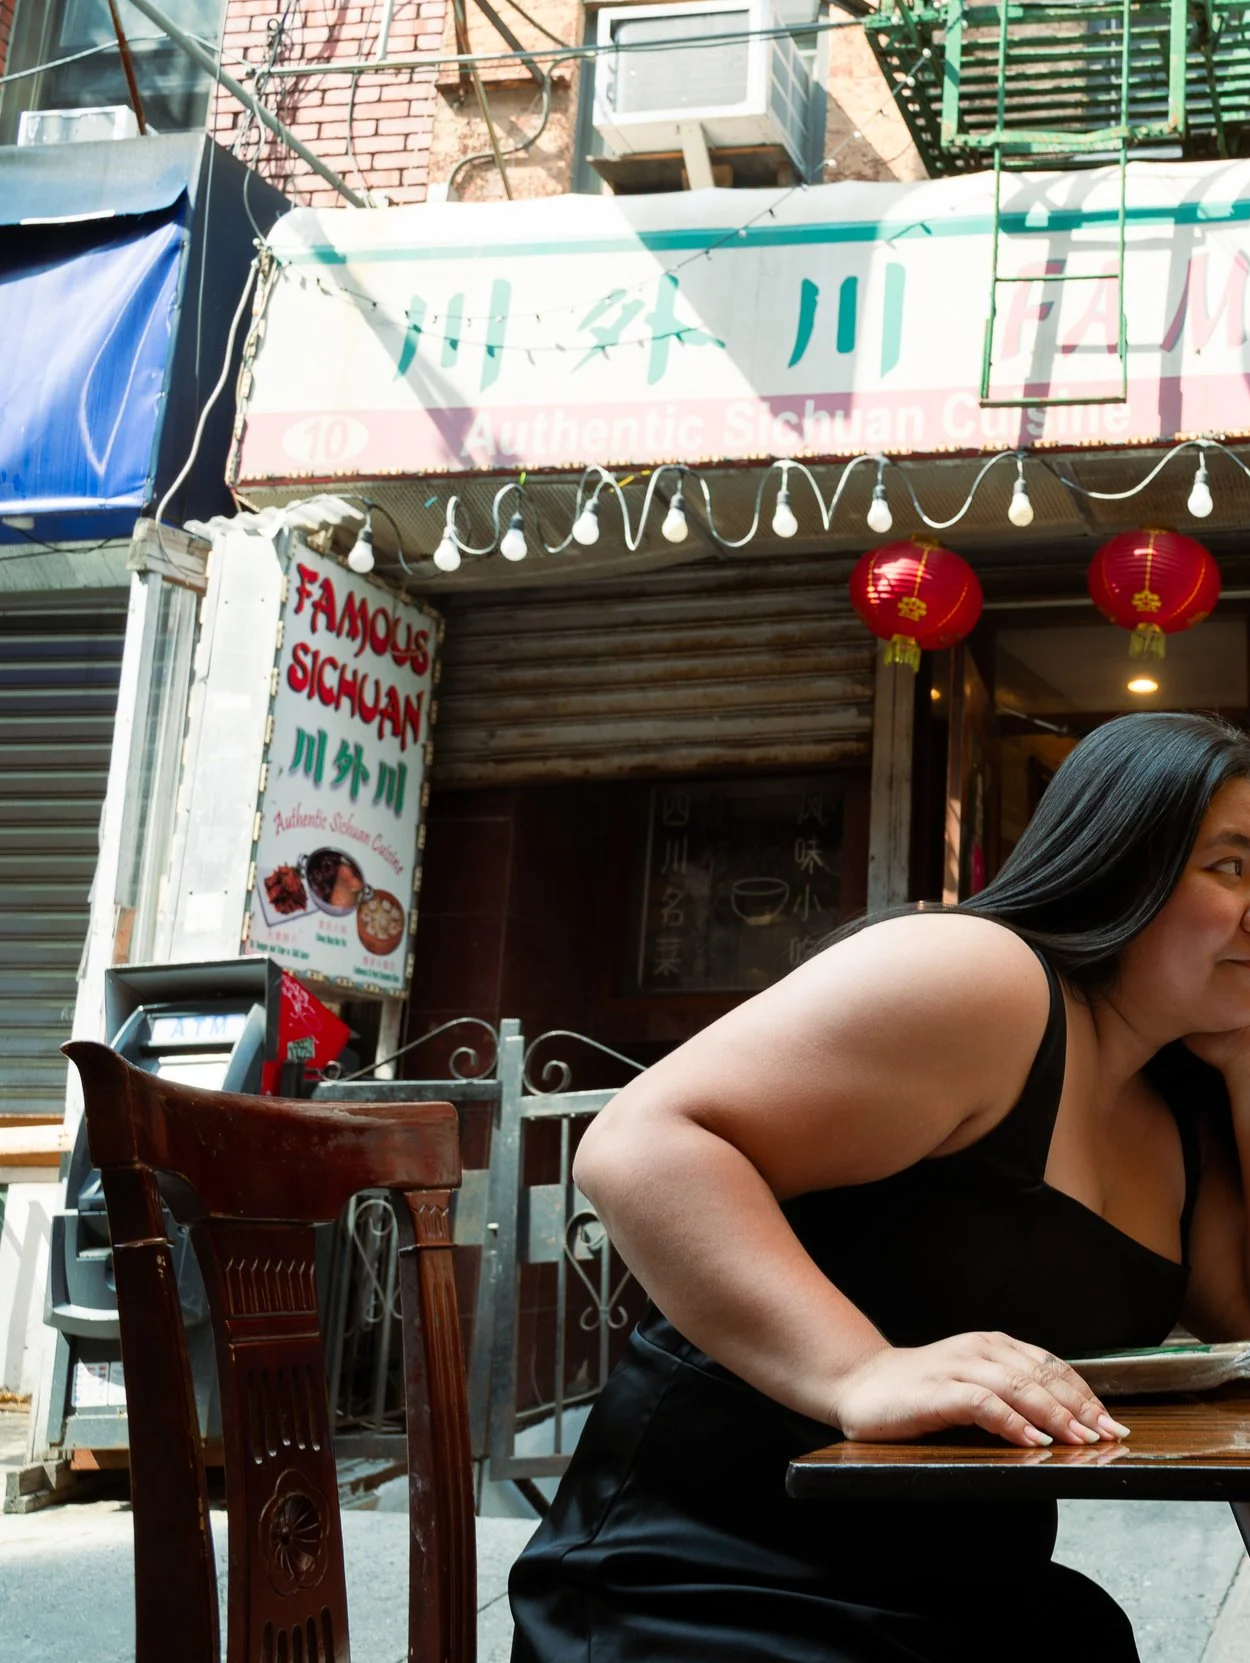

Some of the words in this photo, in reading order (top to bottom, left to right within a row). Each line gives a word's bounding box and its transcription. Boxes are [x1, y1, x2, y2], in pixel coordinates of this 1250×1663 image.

[392, 263, 906, 393] 川外川
[303, 416, 349, 459] 10
[461, 402, 702, 458] Authentic
[724, 396, 928, 450] Sichuan
[942, 383, 1131, 438] Cuisine
[295, 562, 430, 677] FAMOUS
[287, 641, 425, 752] SICHUAN
[288, 727, 409, 820] 川外川
[272, 802, 328, 837] Authentic
[329, 811, 372, 846] Sichuan
[371, 833, 405, 876] Cuisine
[653, 791, 690, 977] 四川名菜
[170, 1014, 229, 1039] ATM
